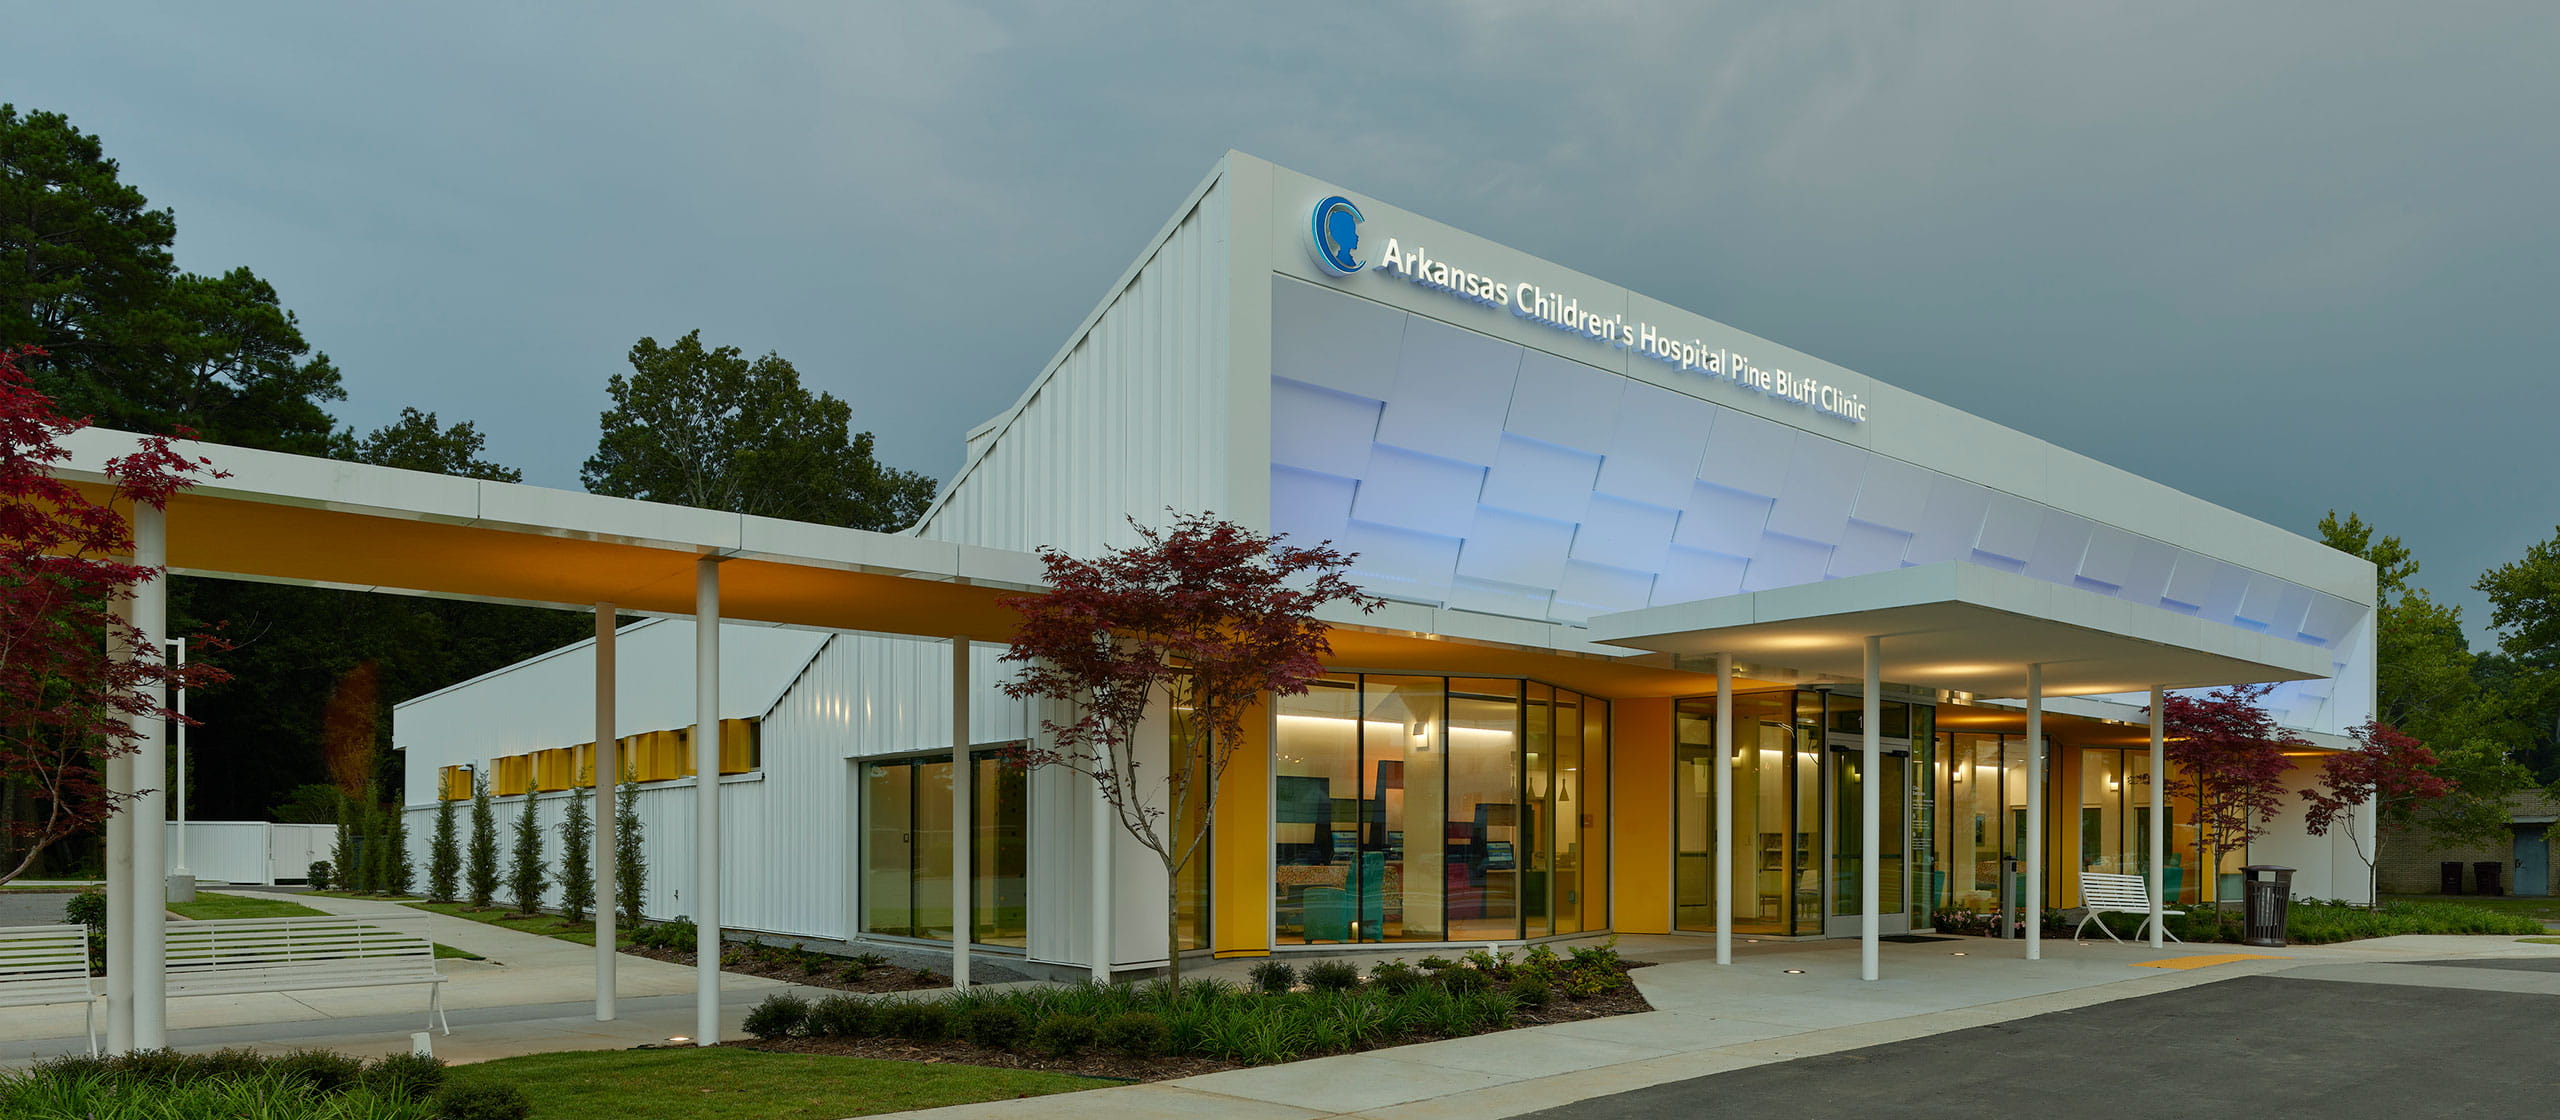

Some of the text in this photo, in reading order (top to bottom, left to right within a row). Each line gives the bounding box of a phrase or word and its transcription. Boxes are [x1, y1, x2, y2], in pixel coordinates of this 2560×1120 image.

[1380, 237, 1867, 422] Arkansas Children's Hospital Pine Bluff Clinic
